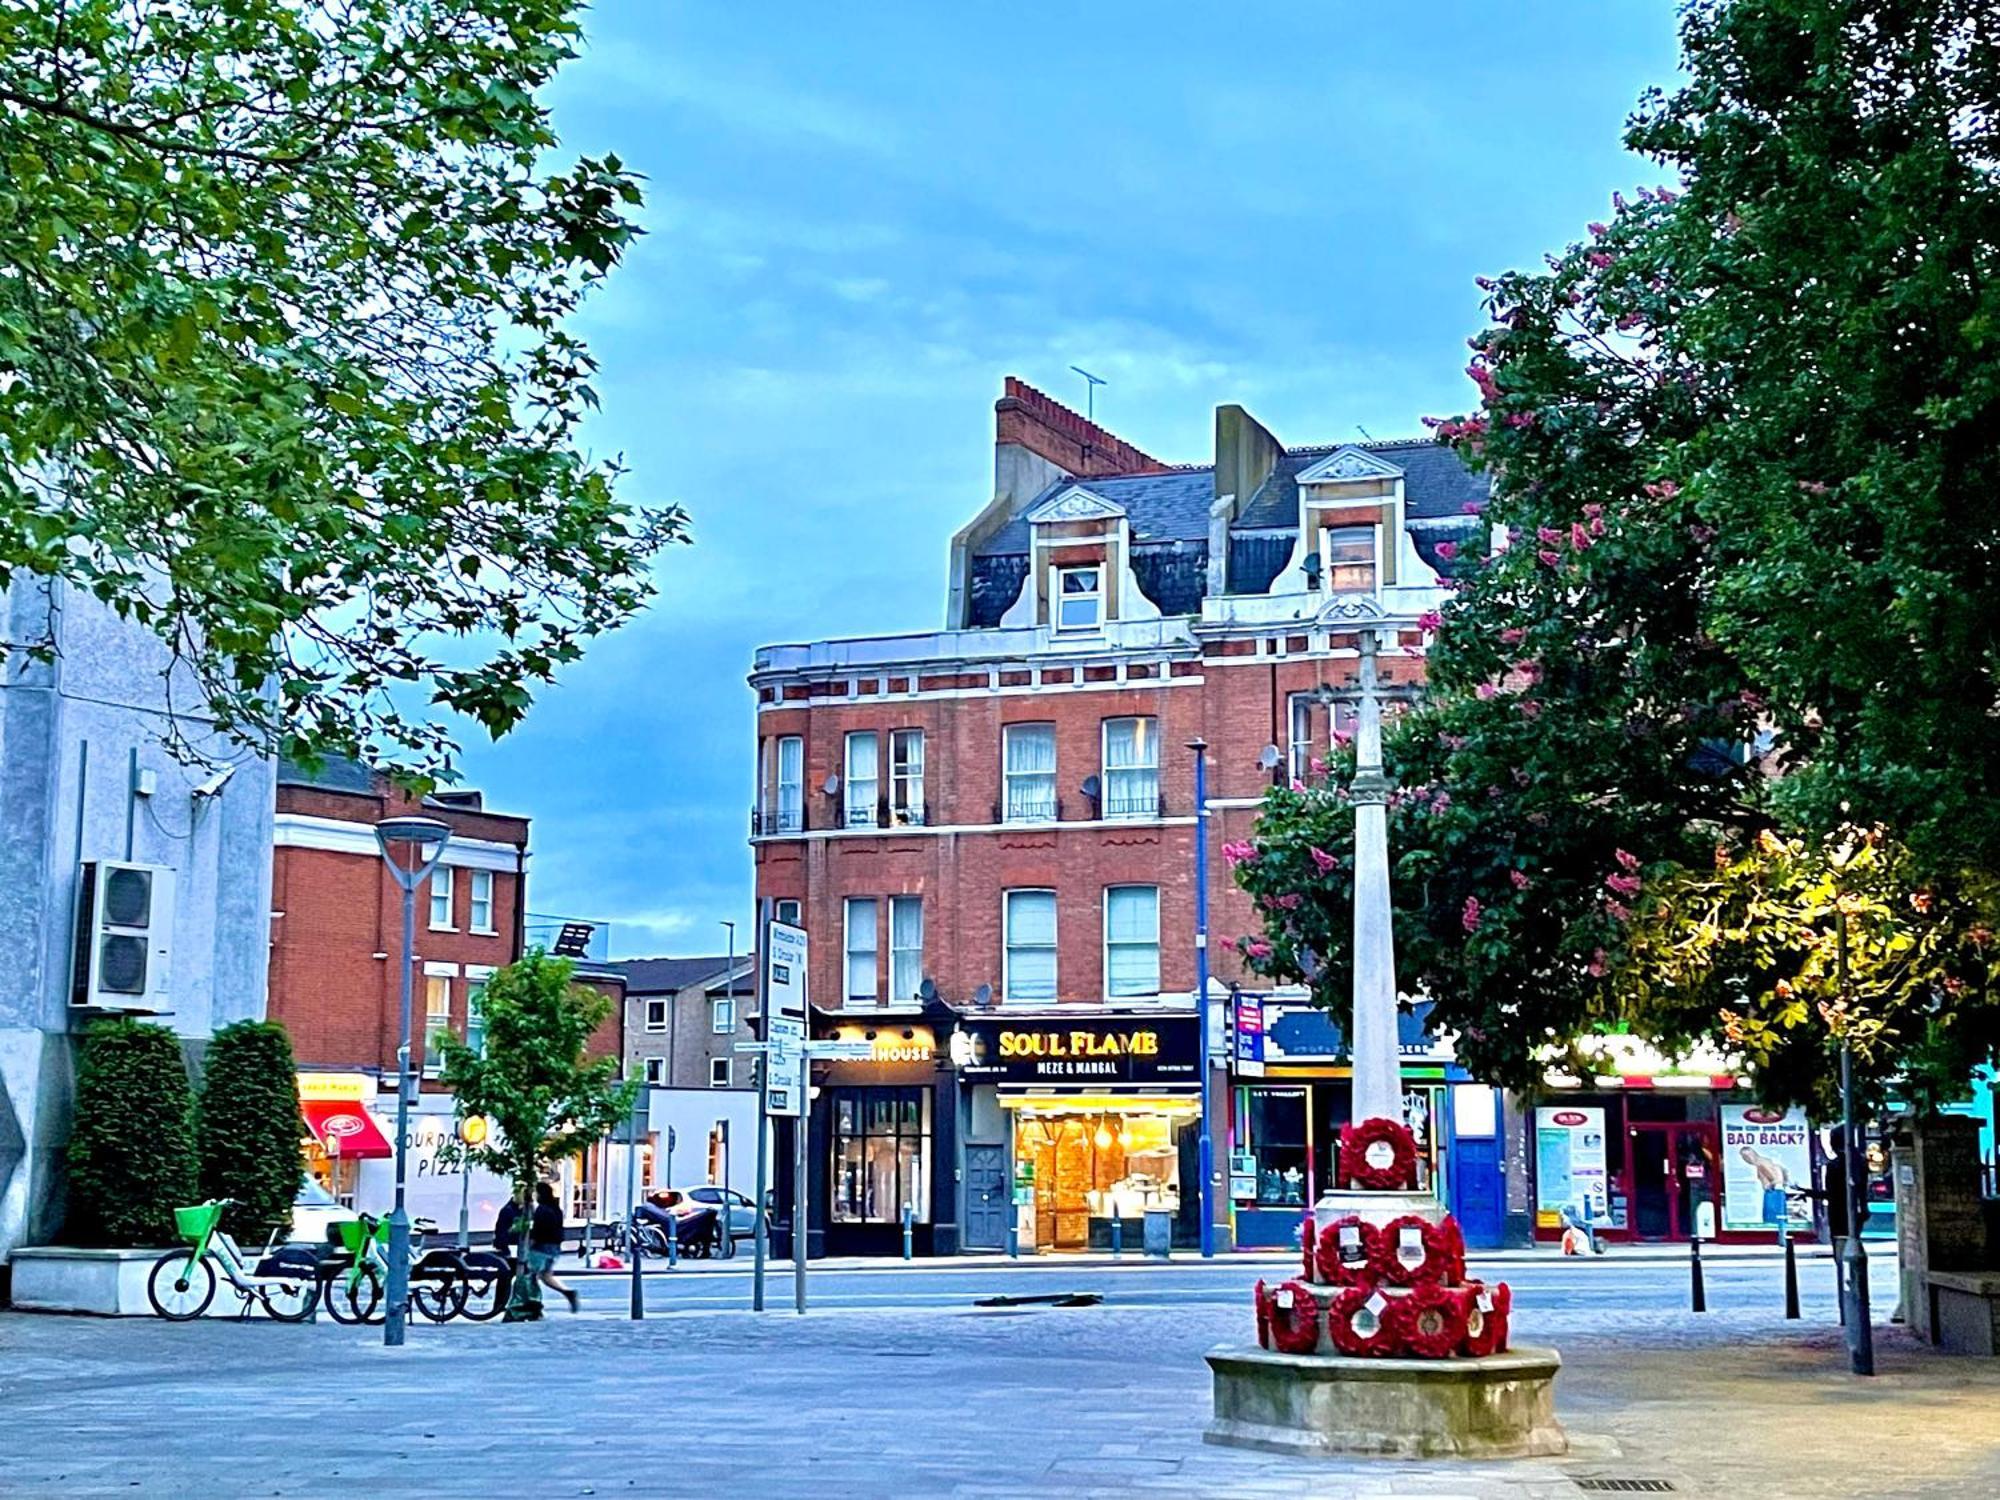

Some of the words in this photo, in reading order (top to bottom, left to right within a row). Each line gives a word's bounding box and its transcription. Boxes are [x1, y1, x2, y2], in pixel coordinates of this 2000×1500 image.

[999, 1031, 1066, 1056] SOUL
[1070, 1031, 1158, 1056] FLAME
[832, 1047, 930, 1062] HOUSE
[1037, 1062, 1064, 1074] MEZE
[1066, 1062, 1074, 1074] &
[1727, 1133, 1755, 1145] BAD
[1760, 1133, 1805, 1145] BACK?
